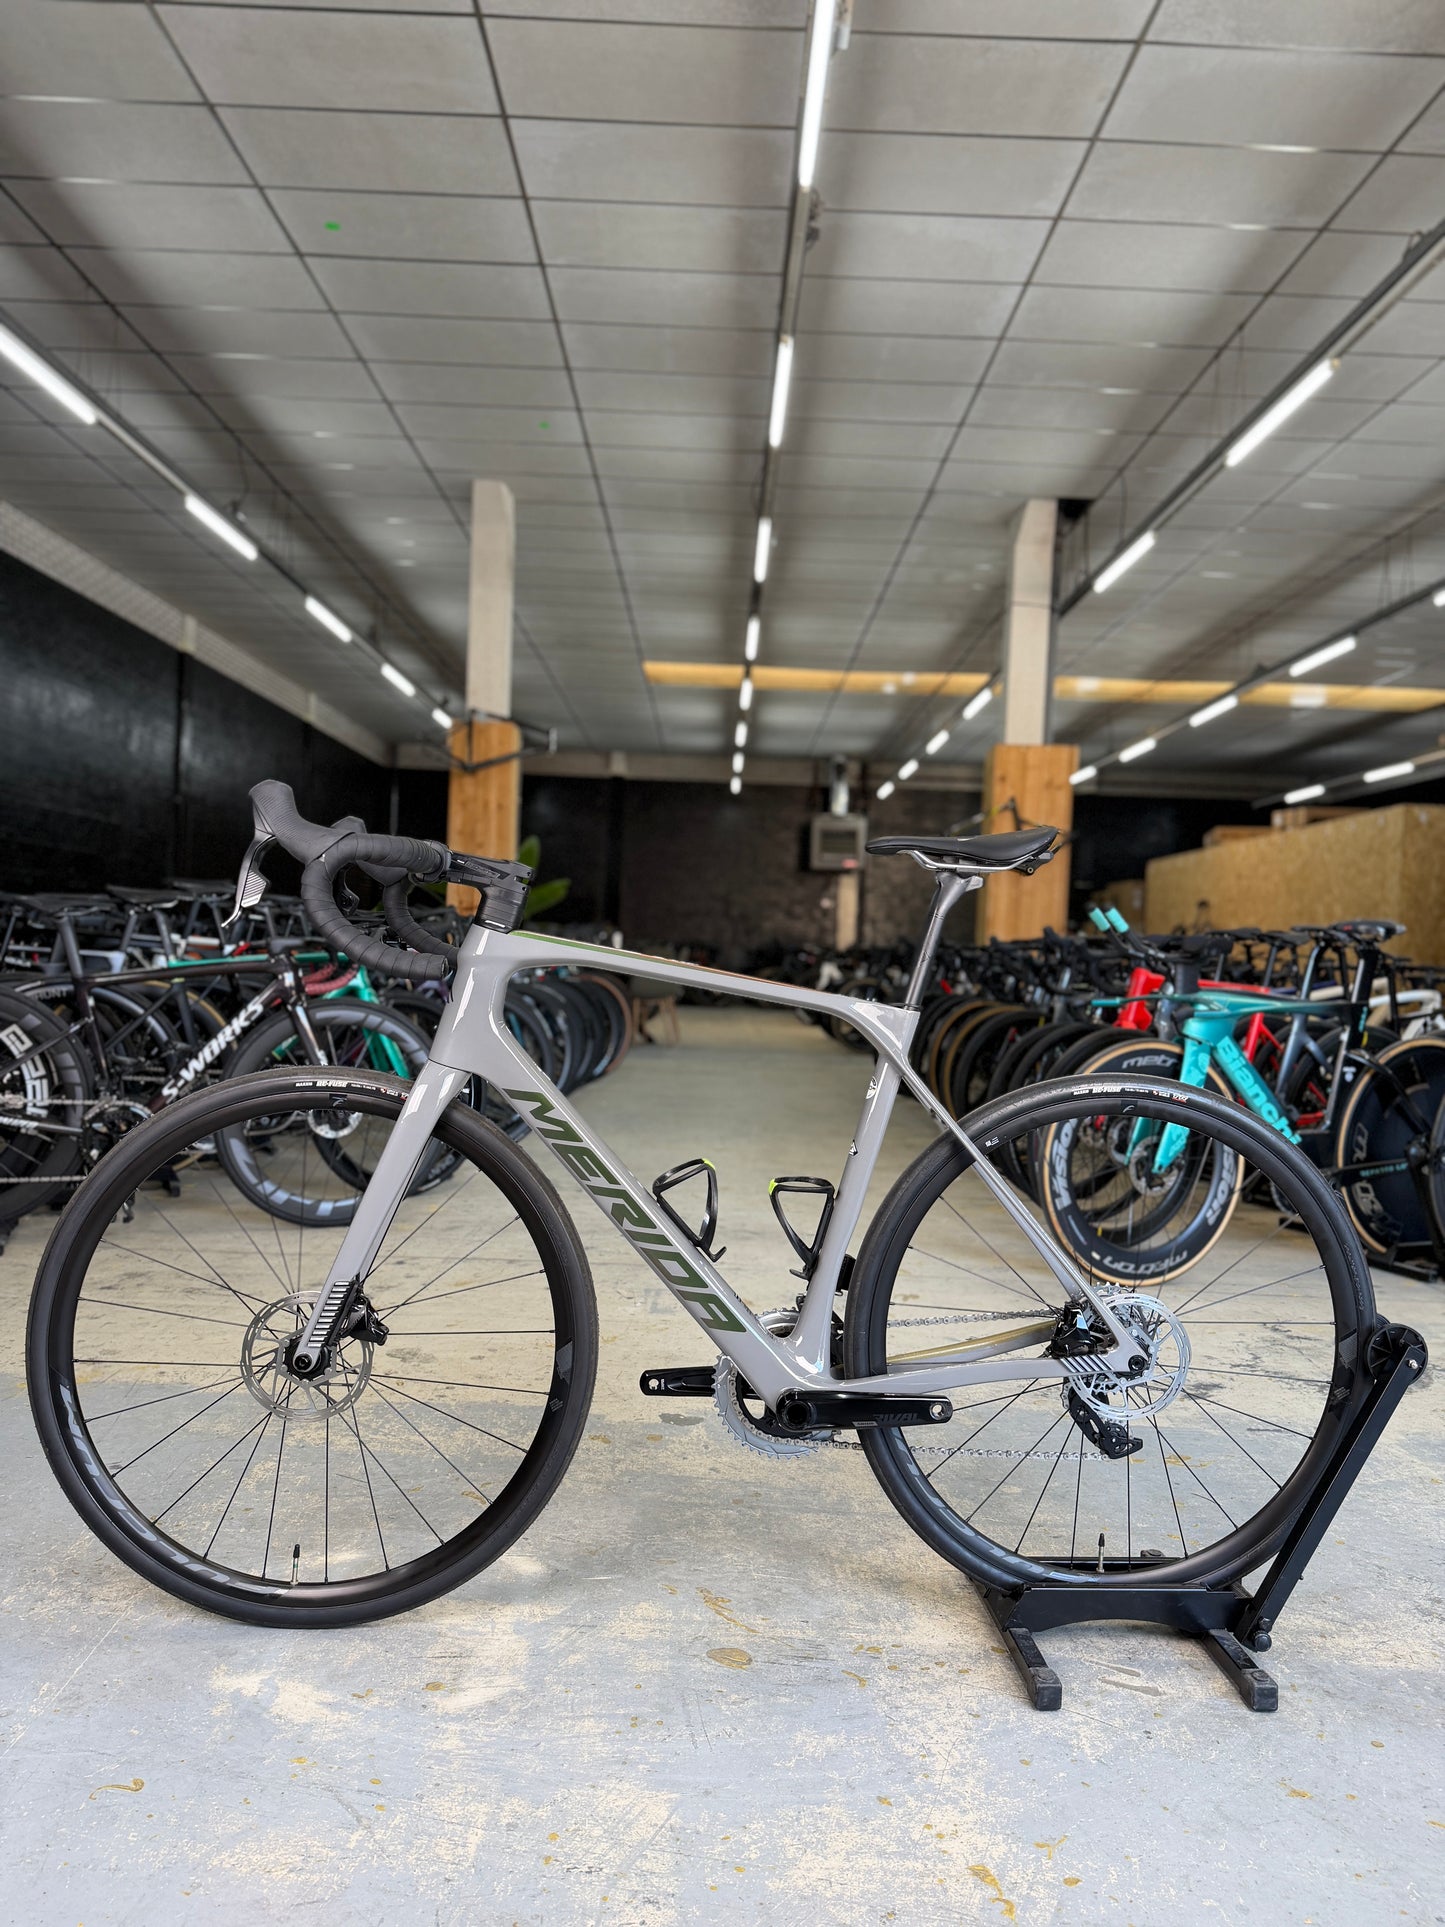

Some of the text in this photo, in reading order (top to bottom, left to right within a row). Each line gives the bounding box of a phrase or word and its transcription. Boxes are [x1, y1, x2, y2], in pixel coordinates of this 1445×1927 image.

[162, 1000, 264, 1104] S-WORKS
[1122, 1053, 1179, 1069] metr
[502, 1087, 748, 1333] MERIDA
[59, 1383, 289, 1597] FULCRUM
